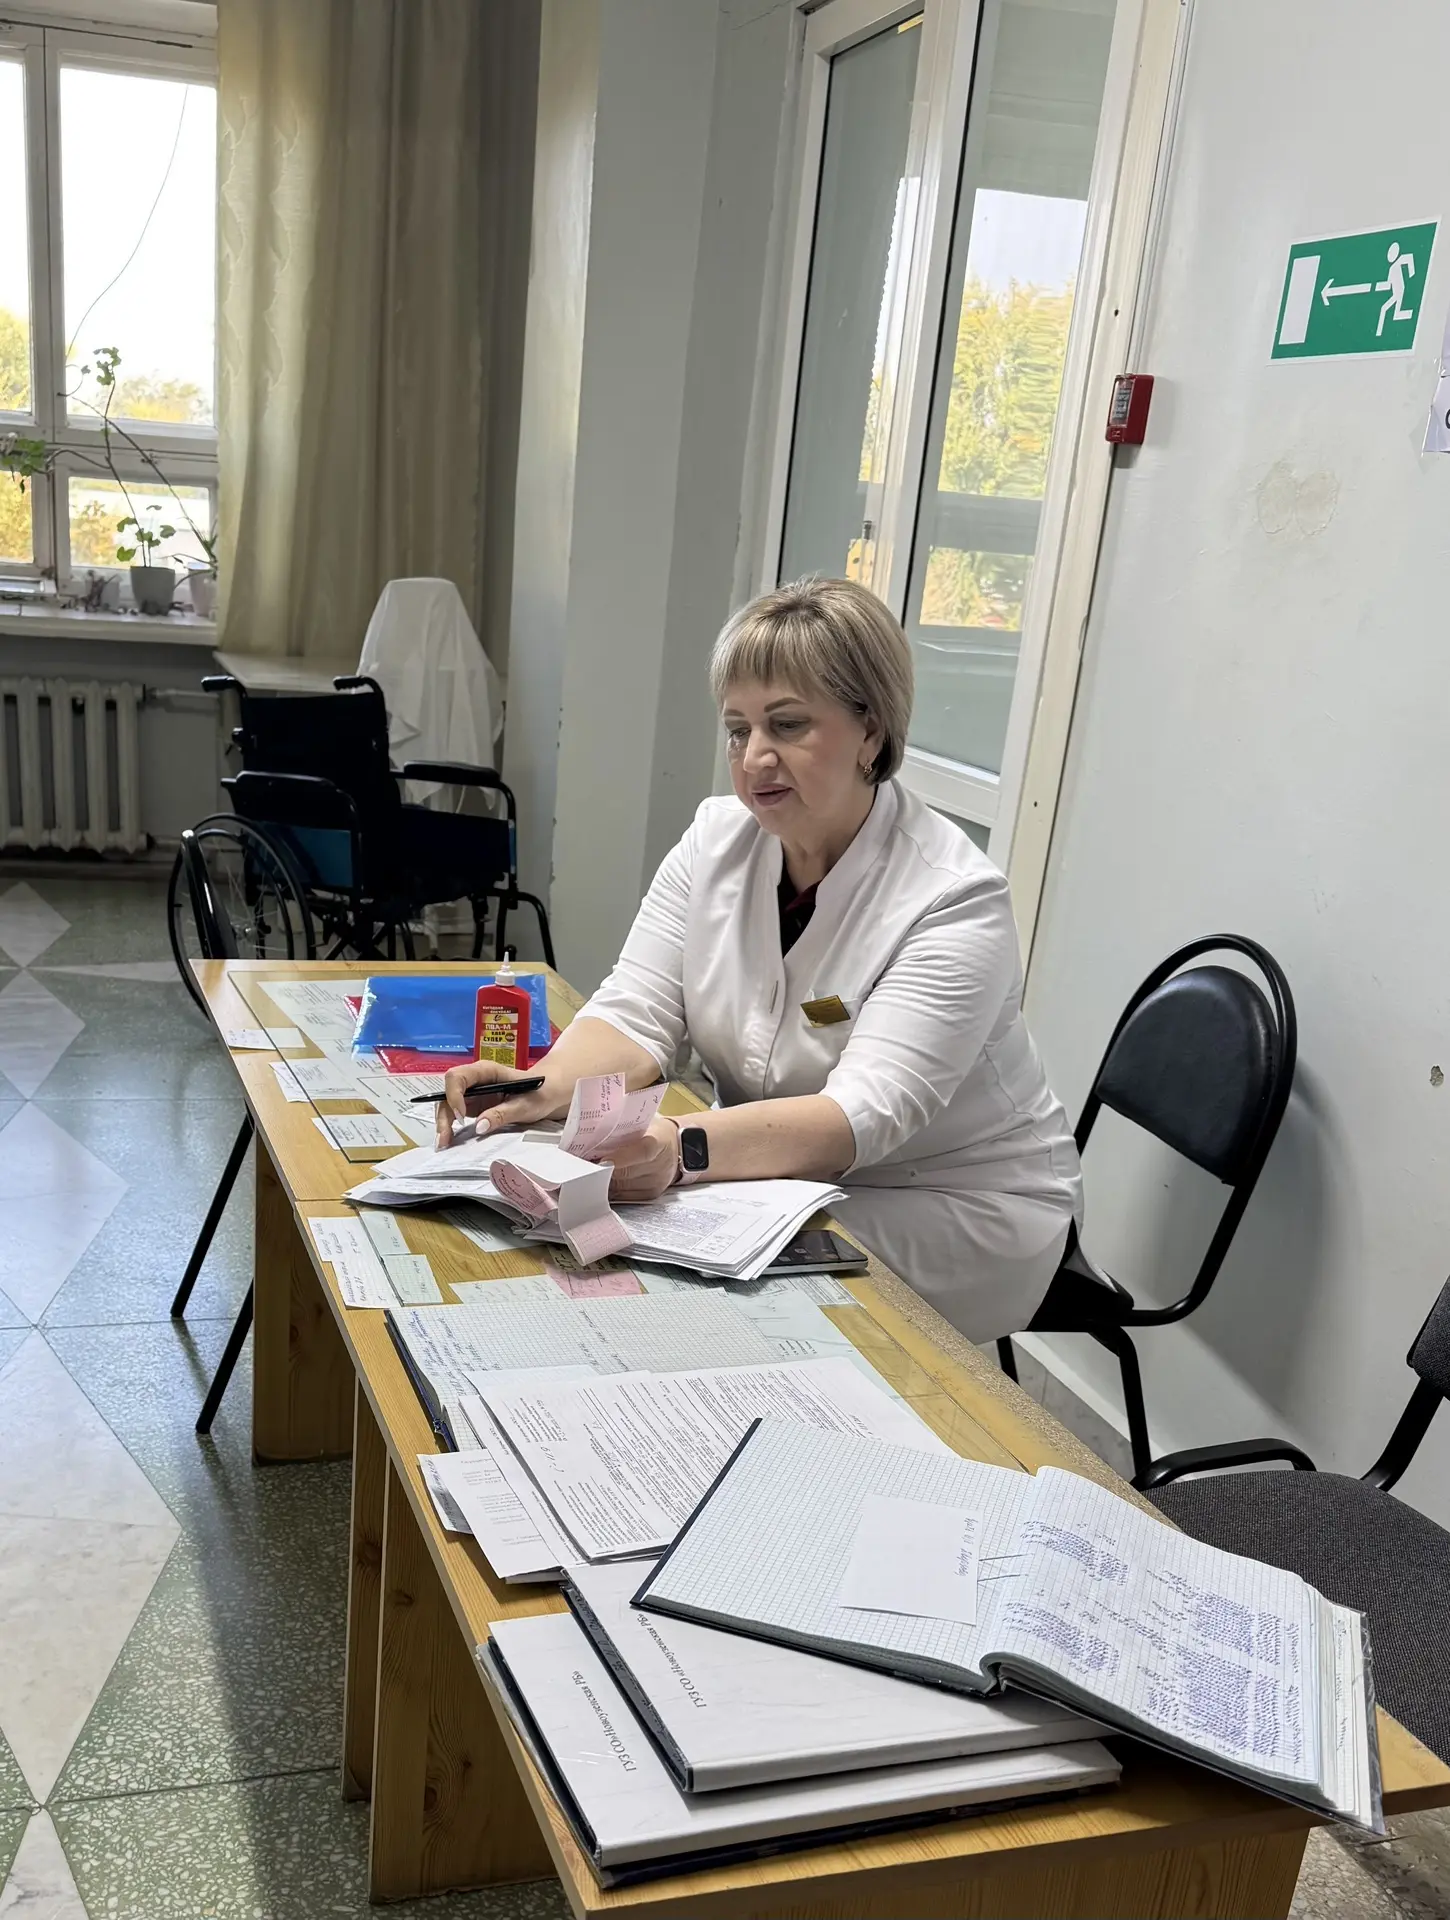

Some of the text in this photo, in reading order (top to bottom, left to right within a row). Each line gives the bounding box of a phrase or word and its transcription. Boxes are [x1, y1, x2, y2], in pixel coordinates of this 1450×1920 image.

[679, 1677, 695, 1691] СО
[688, 1690, 707, 1708] ГУЗ
[618, 1753, 637, 1772] ГУЗ
